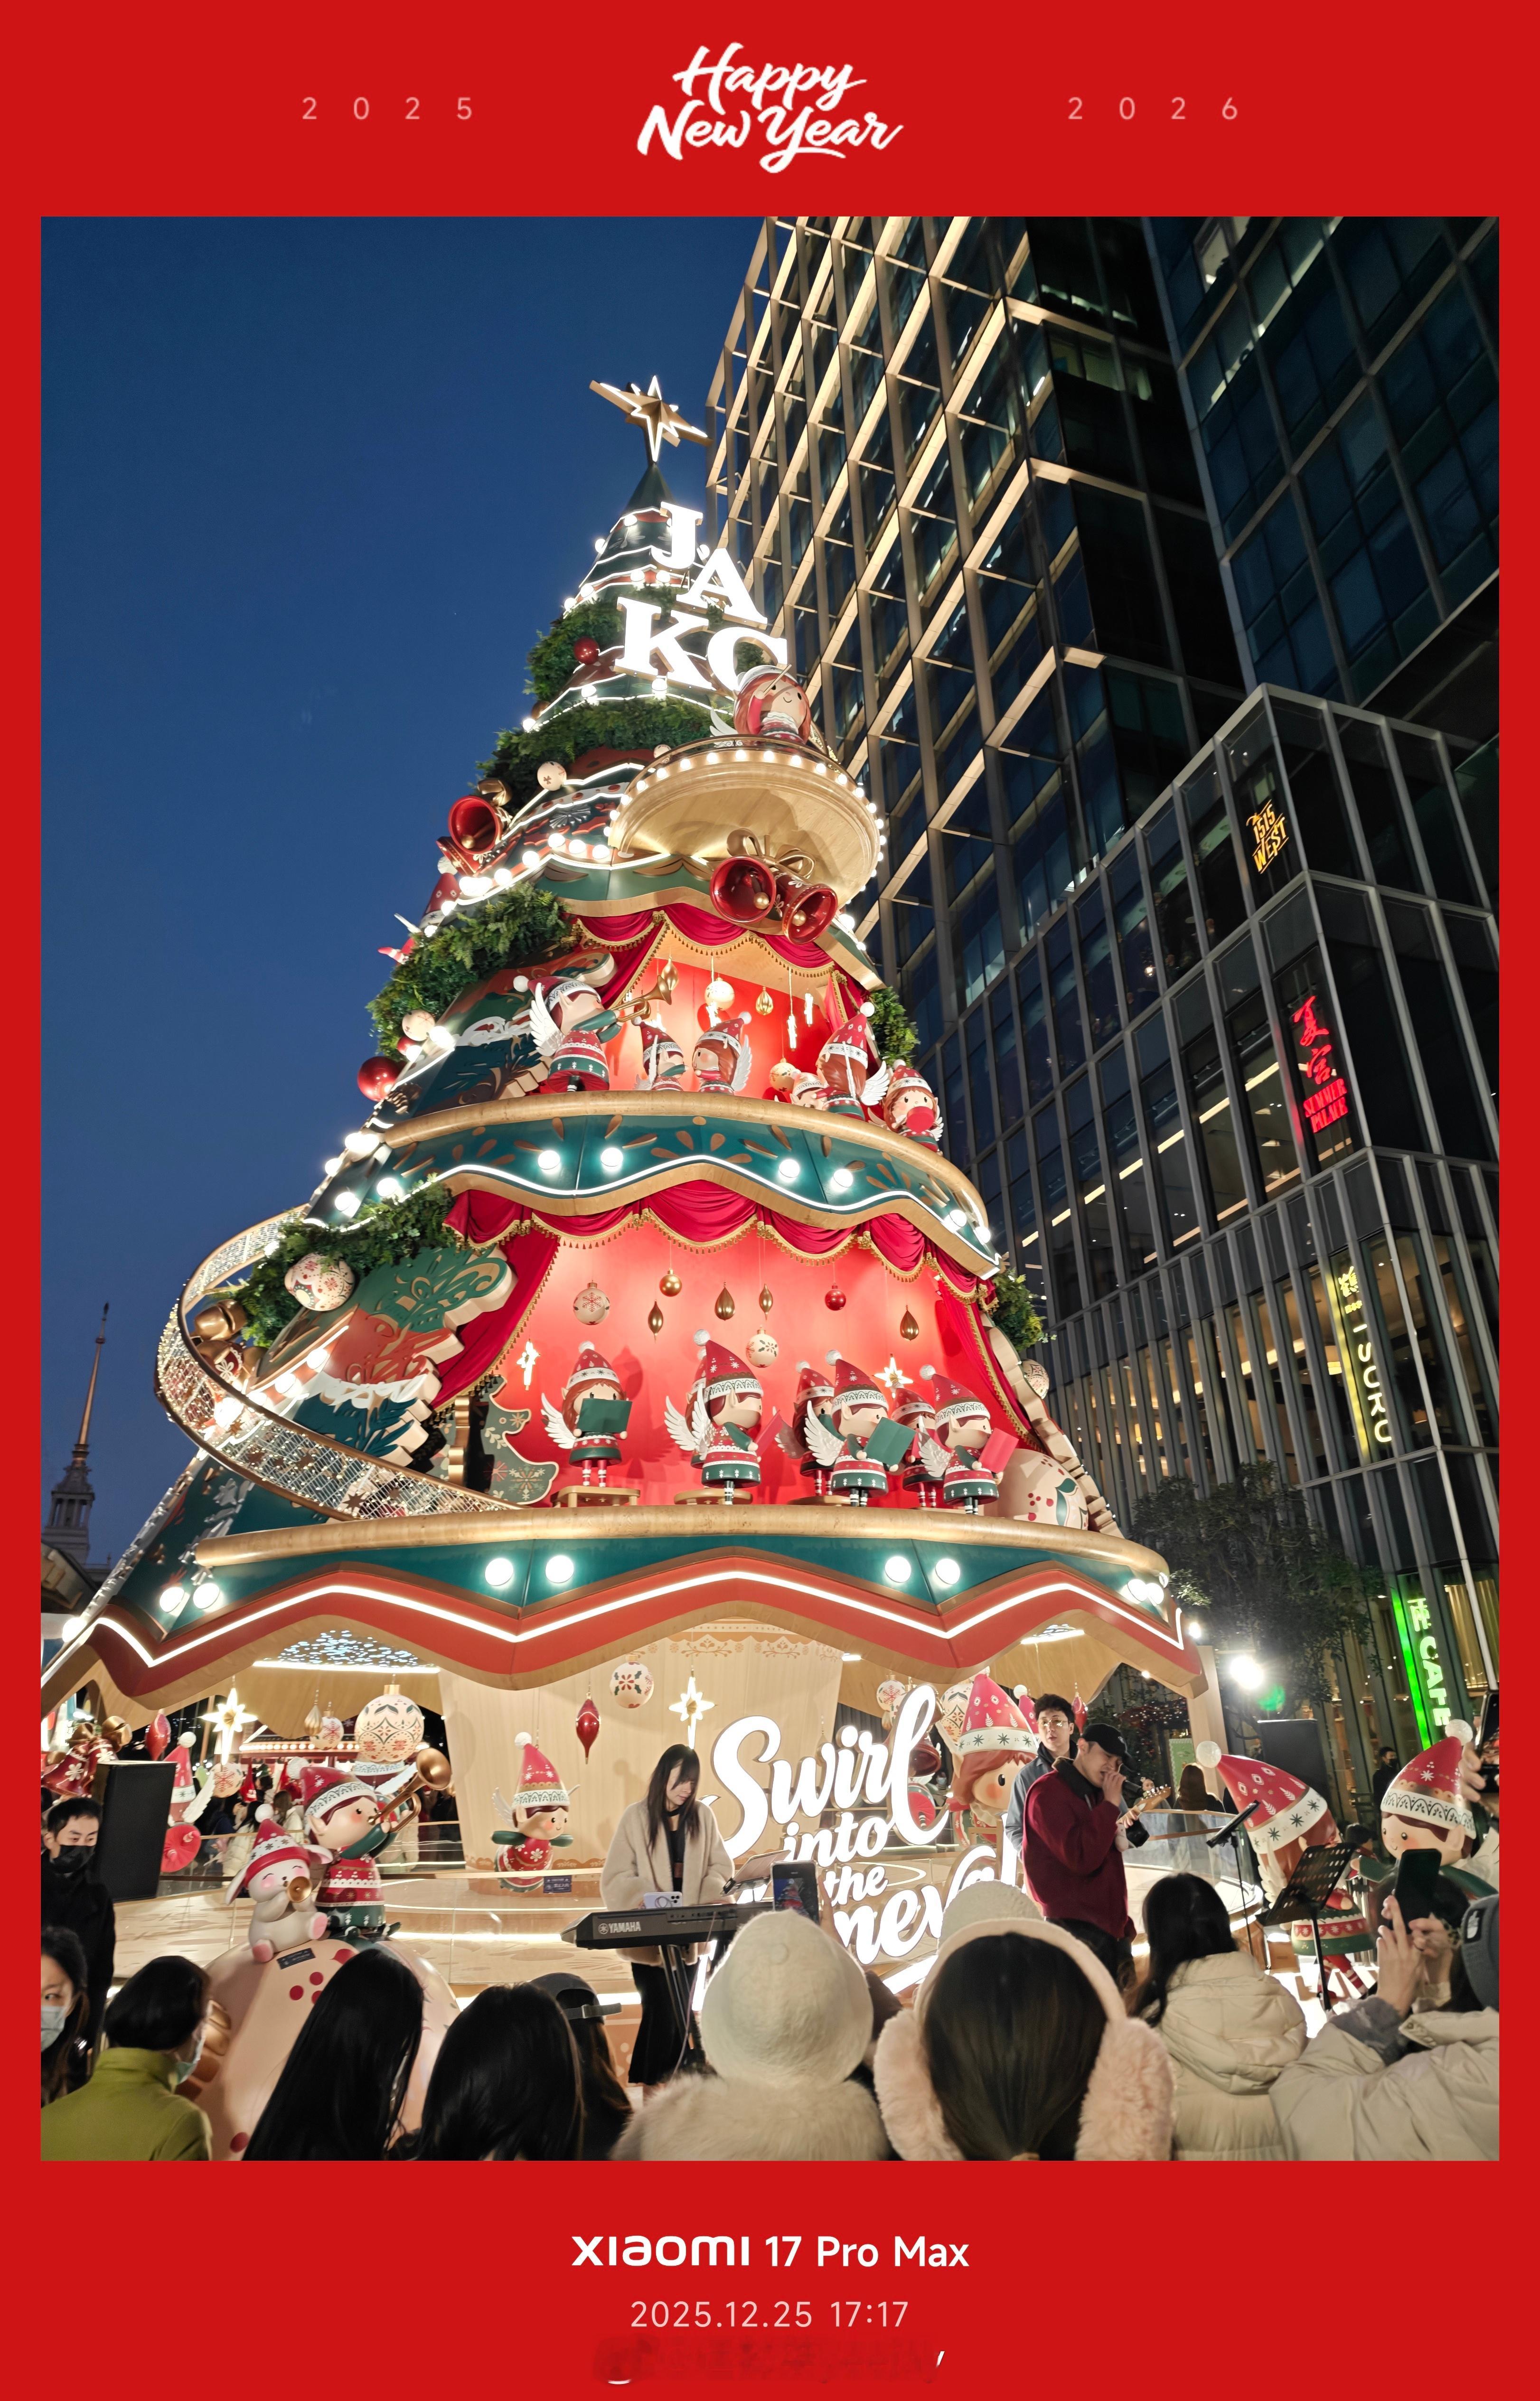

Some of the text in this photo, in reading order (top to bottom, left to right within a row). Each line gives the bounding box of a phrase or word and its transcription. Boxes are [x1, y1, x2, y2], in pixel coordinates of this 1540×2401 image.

[1253, 804, 1276, 844] 1515
[1254, 817, 1286, 872] WEST
[1303, 1079, 1347, 1117] SUMMER
[699, 1684, 949, 1860] Swirl
[781, 1811, 894, 1867] into
[823, 1866, 888, 1907] the
[609, 1921, 641, 1933] YAMAHA
